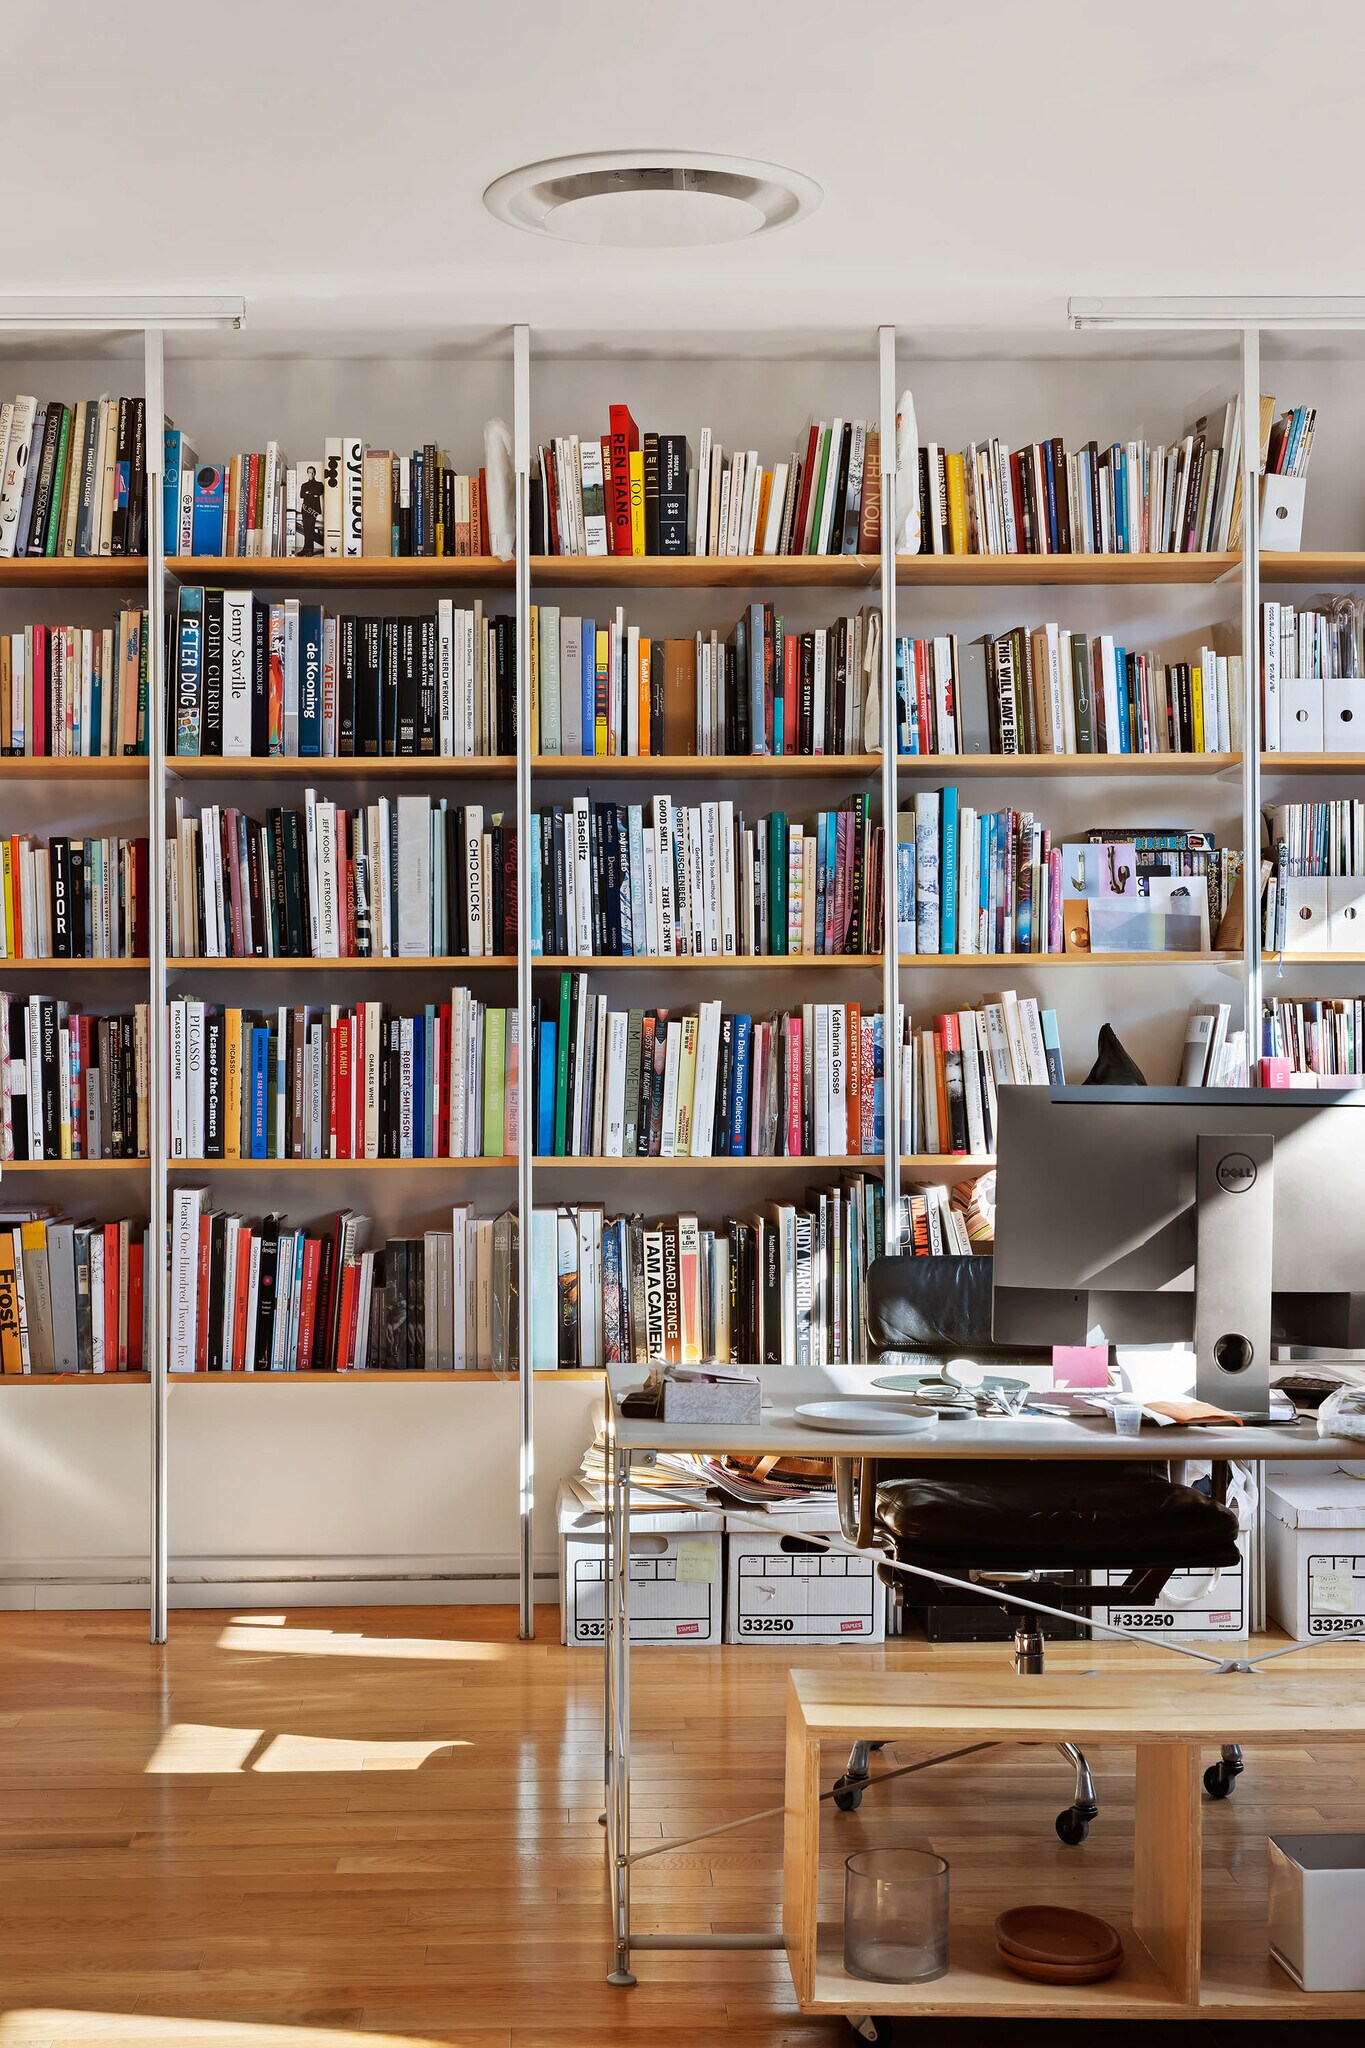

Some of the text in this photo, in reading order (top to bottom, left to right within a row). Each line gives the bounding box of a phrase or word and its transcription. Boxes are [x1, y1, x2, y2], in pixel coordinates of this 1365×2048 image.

[36, 415, 58, 516] MODERN FURNITURE DESIGNS
[614, 433, 628, 526] REN HANG
[630, 479, 642, 506] 100
[863, 454, 880, 538] ART NOW
[181, 618, 199, 706] PETER DOIG
[228, 602, 246, 699] Jenny Saville
[257, 636, 263, 646] DE
[429, 663, 433, 671] OF
[207, 615, 220, 729] JOHN CURRIN
[305, 643, 318, 718] de Kooning
[324, 664, 333, 719] ATELIER
[998, 640, 1016, 754] THIS WILL HAVE BEEN
[577, 810, 587, 860] Baselitz
[659, 799, 667, 854] GOOD SMELL
[55, 845, 66, 933] TIBOR
[471, 873, 480, 922] CLICKS
[678, 841, 686, 908] RAUSCHENBERG
[43, 1005, 54, 1062] Tord Boontje
[190, 1015, 200, 1071] PICASSO
[645, 1026, 653, 1049] GHOSTS
[737, 1040, 745, 1060] Dakis
[832, 1010, 842, 1094] Katharina Grosse
[209, 1025, 218, 1137] Picasso & the Camera
[626, 1012, 640, 1115] UNMONUMENTAL
[643, 1072, 651, 1100] MACHINE
[736, 1063, 744, 1094] Joannou
[735, 1096, 743, 1133] Collection
[1221, 1168, 1253, 1178] DELL
[912, 1199, 928, 1246] WILLIAM
[175, 1197, 191, 1366] Hearst One Hundred Twenty Five
[647, 1245, 659, 1273] AM
[647, 1276, 660, 1288] A
[665, 1235, 677, 1338] RICHARD PRINCE
[797, 1217, 811, 1315] ANDY WARHOL
[742, 1619, 794, 1632] 33250
[1113, 1614, 1174, 1628] #33250
